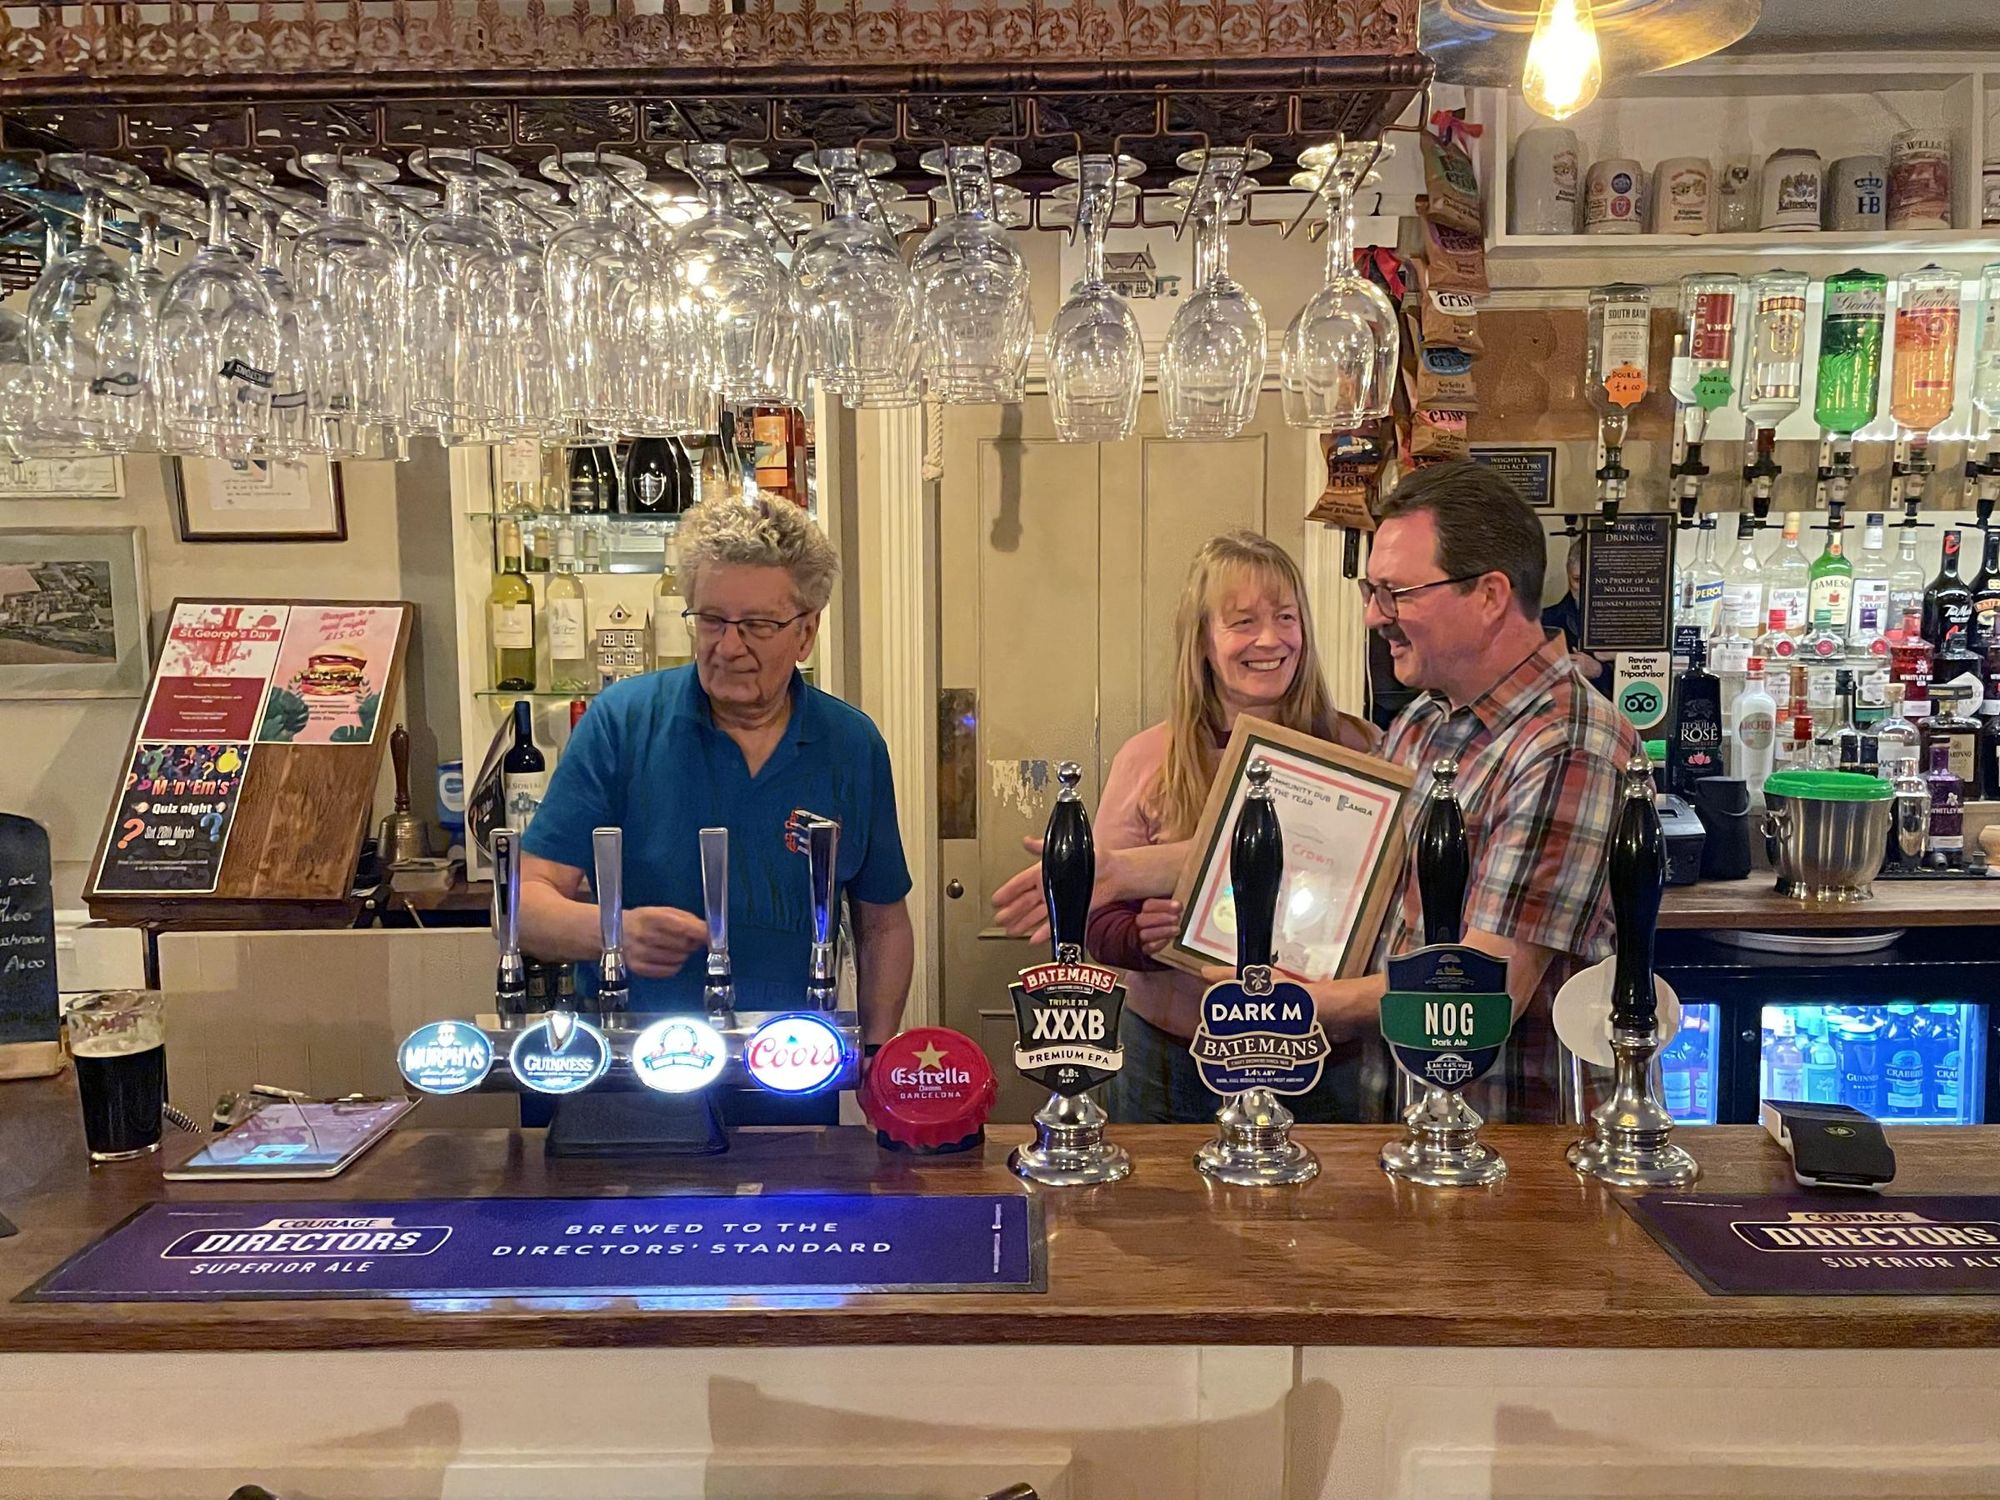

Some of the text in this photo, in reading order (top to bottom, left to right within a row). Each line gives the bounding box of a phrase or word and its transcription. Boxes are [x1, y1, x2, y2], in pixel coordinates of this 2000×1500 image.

[1608, 308, 1631, 320] SOUTH
[1692, 296, 1708, 358] CHEKOV
[1612, 370, 1642, 379] DOUBLE
[1700, 374, 1729, 383] DOUBLE
[1604, 533, 1654, 543] DRINKING
[1595, 577, 1608, 585] NO
[1609, 577, 1632, 585] PROOF
[1634, 577, 1644, 585] OF
[1603, 585, 1651, 593] NO ALCOHOL
[249, 630, 273, 640] Day
[1628, 656, 1658, 664] Review
[1620, 670, 1665, 679] Tripadvisor
[1681, 722, 1718, 730] TEQUILA
[1680, 728, 1719, 743] ROSE
[1269, 776, 1331, 802] OMMUNITY PUB
[1274, 787, 1314, 806] THE YEAR
[152, 803, 213, 816] Quiz night
[1025, 967, 1113, 989] BATEMANS
[1048, 998, 1089, 1006] TRIPLE XB
[1211, 1002, 1303, 1021] DARK M
[1031, 1008, 1106, 1040] XXXB
[1424, 1002, 1474, 1036] NOG
[1202, 1037, 1319, 1058] BATEMANS
[1431, 1038, 1469, 1047] Dark Ale
[744, 1037, 838, 1069] Coors
[1028, 1049, 1110, 1065] PREMIUM EPA
[523, 1055, 594, 1073] GUINNESS
[890, 1066, 971, 1086] Estrella
[1058, 1068, 1080, 1078] 4.8%
[899, 1091, 961, 1100] BARCELONA
[278, 1219, 378, 1229] COURAGE
[1804, 1213, 1912, 1223] COURAGE
[564, 1222, 839, 1235] BREWED TO THE
[191, 1231, 422, 1253] DIRECTORS
[1759, 1226, 2000, 1247] DIRECTORS
[491, 1243, 892, 1256] DIRECTORS' STANDARD
[190, 1261, 374, 1275] SUPERIOR ALE
[1821, 1256, 1955, 1269] SUPERIOR
